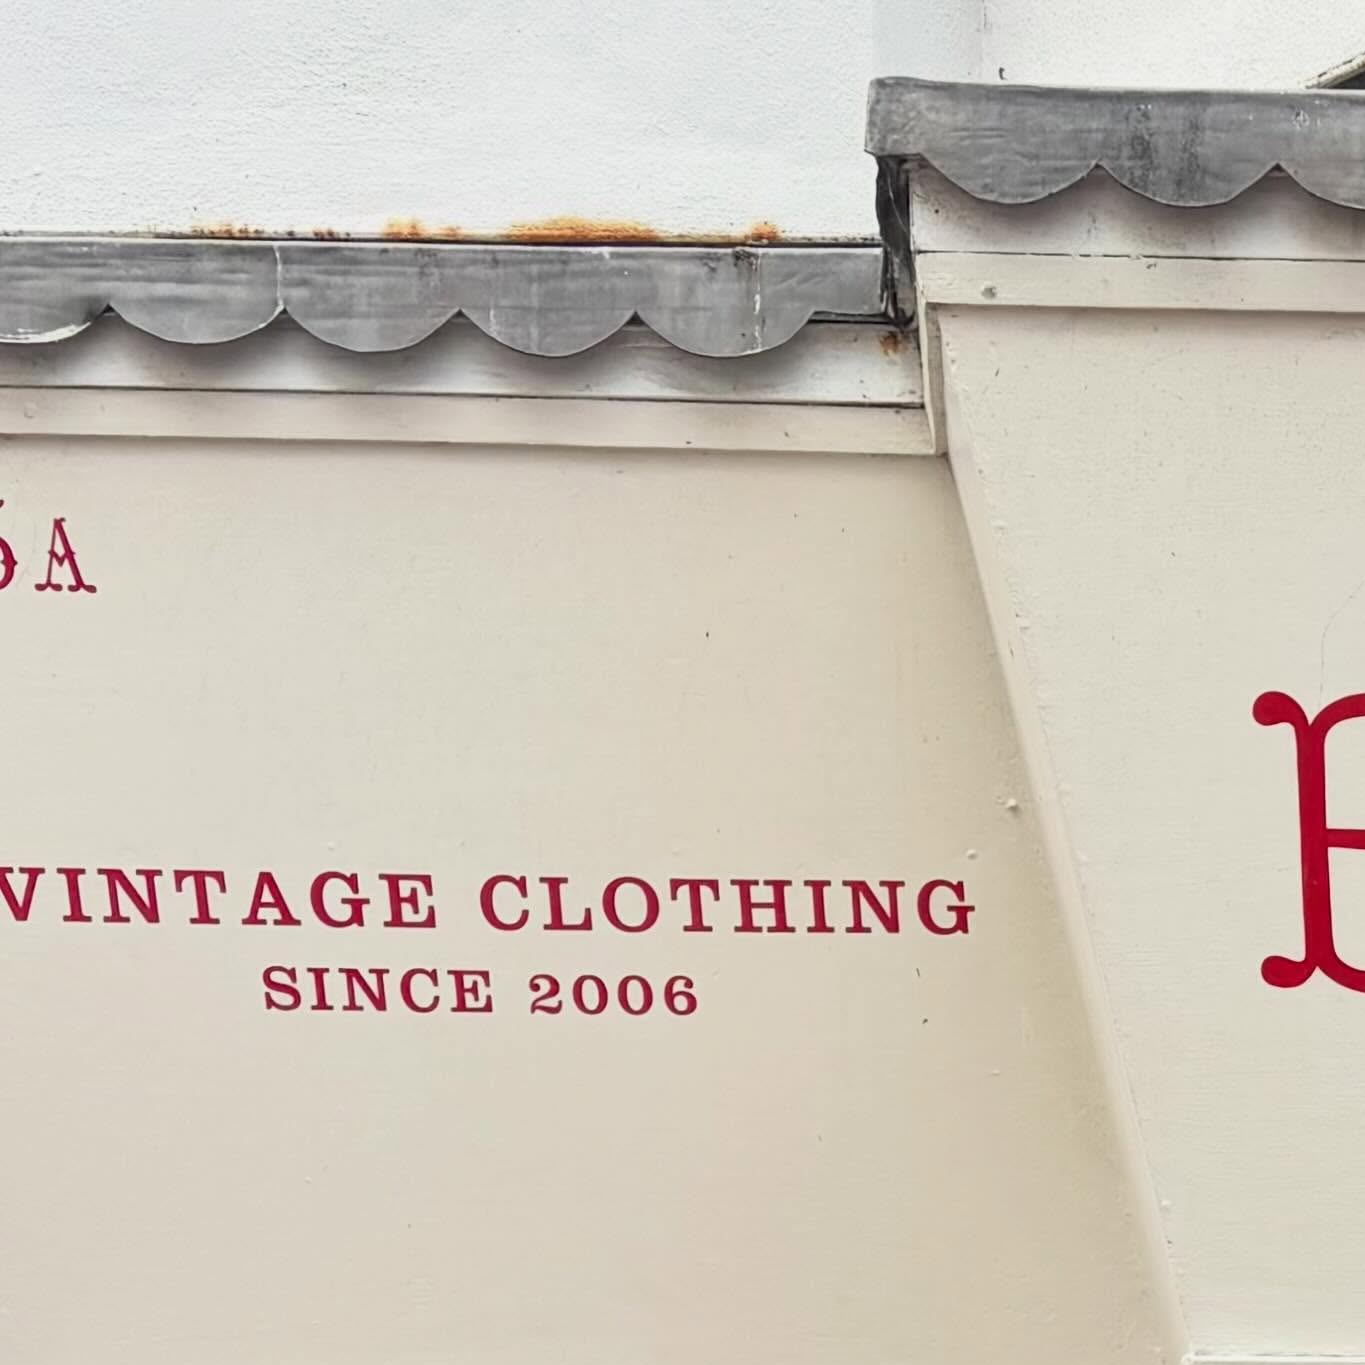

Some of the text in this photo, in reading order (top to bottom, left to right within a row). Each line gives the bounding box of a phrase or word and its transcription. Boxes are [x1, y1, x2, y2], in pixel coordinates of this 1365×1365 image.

[0, 866, 976, 937] VINTAGE CLOTHING
[262, 966, 699, 1017] SINCE 2006
